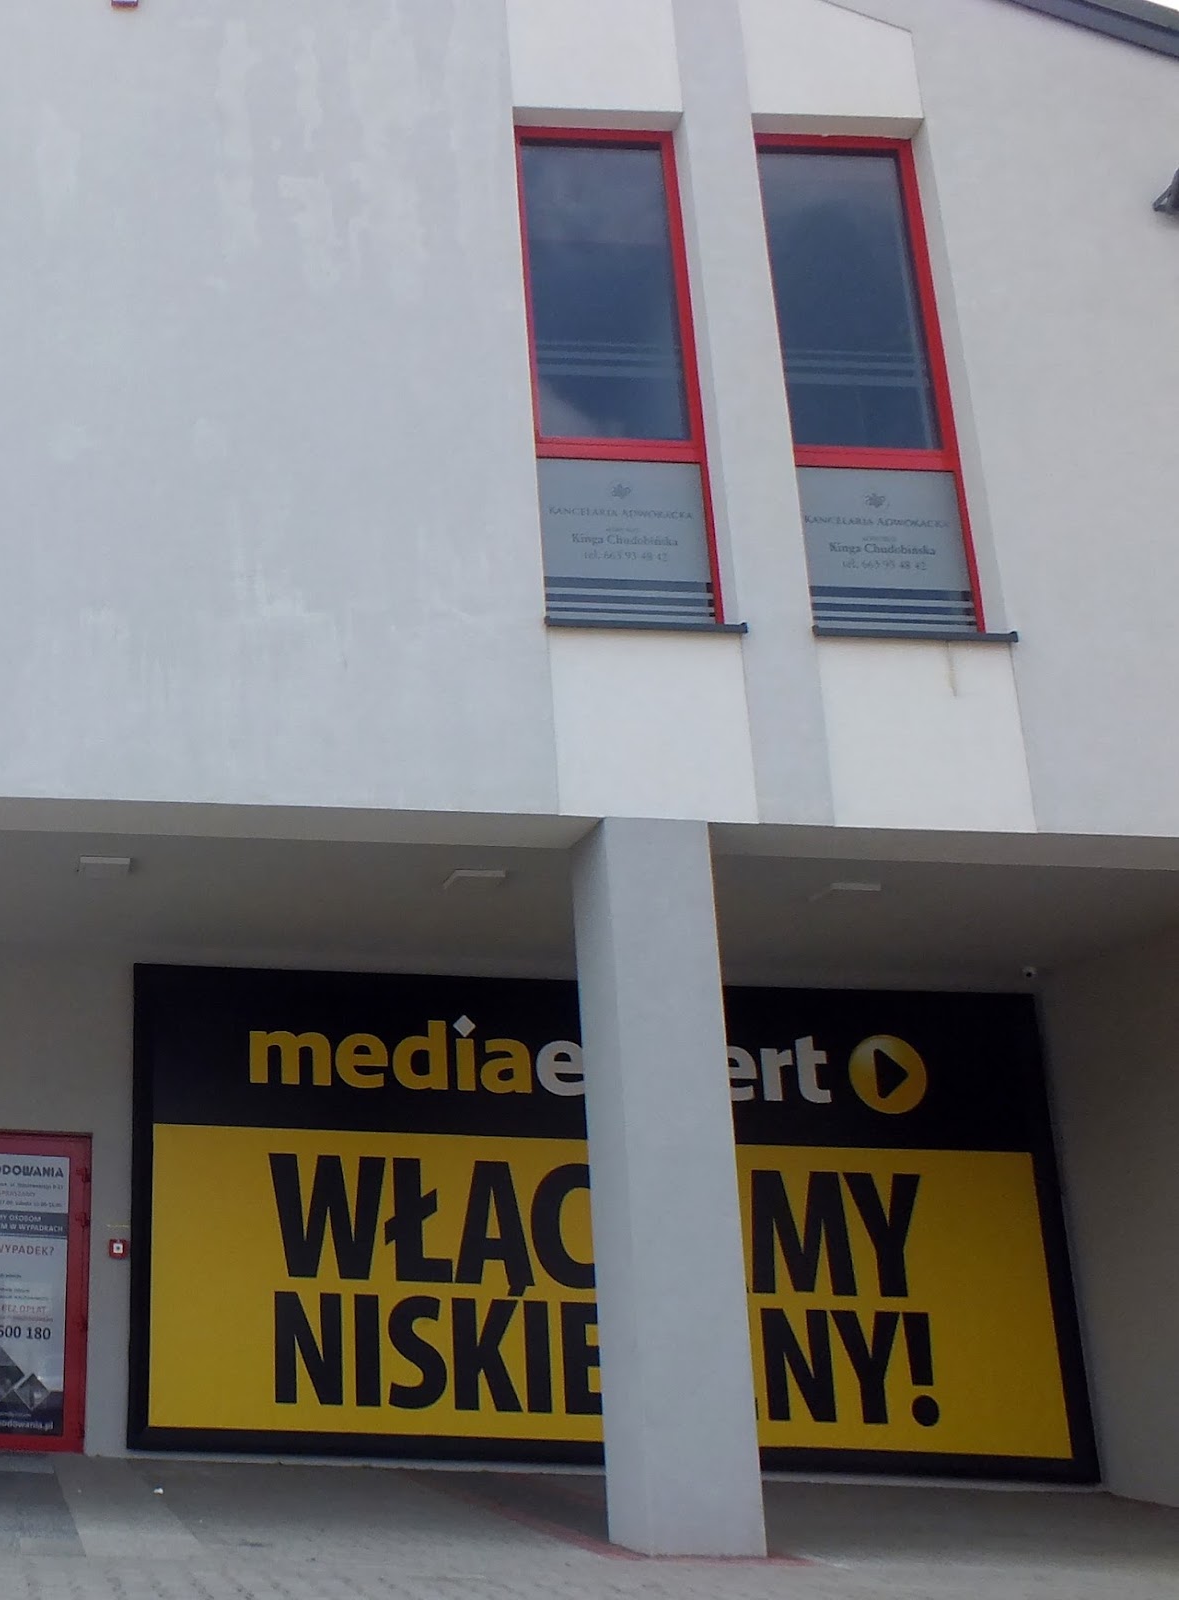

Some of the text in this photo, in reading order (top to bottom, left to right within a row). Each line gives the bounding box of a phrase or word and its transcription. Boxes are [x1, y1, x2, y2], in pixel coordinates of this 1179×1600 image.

[18, 1224, 63, 1232] WYPADKACH
[268, 1152, 921, 1298] WŁĄCMY
[26, 1326, 51, 1340] 180
